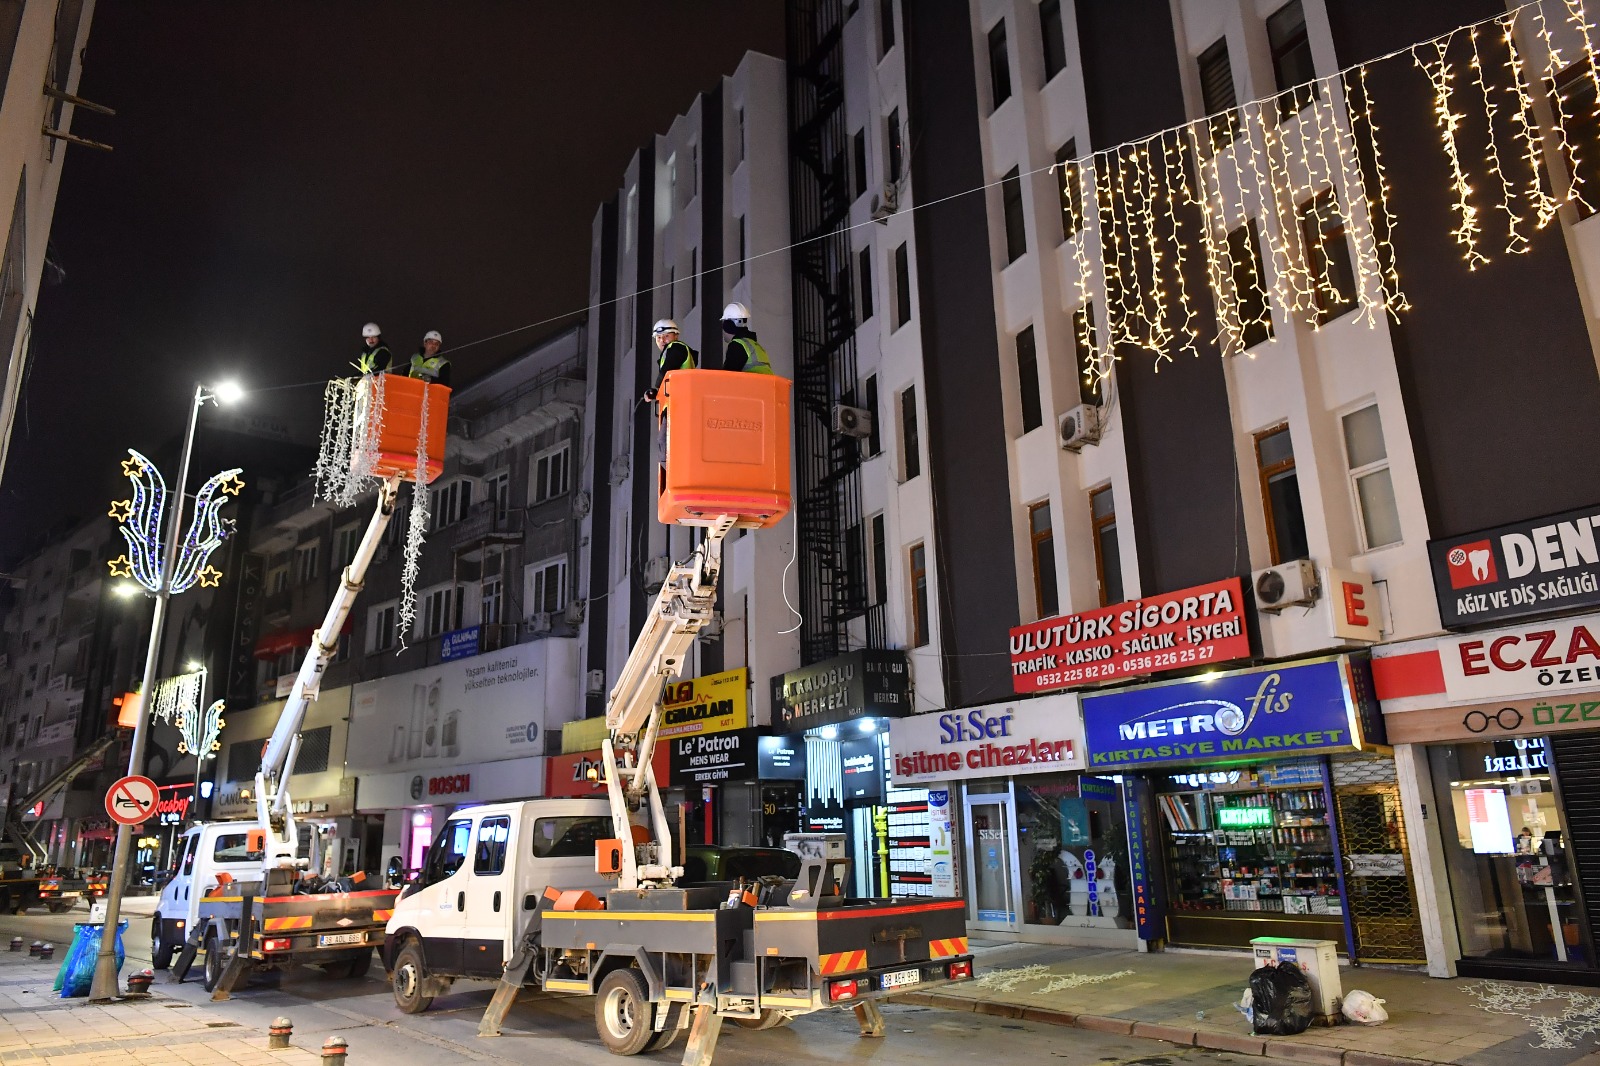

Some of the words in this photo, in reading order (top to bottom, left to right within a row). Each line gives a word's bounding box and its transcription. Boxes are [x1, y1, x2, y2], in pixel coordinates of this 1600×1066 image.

[1342, 581, 1369, 627] E
[1457, 594, 1489, 616] AĞIZ
[1489, 589, 1509, 609] VE
[1513, 583, 1537, 606] DİŞ
[1540, 573, 1598, 601] SAĞLIĞI
[1010, 615, 1114, 656] ULUTÜRK
[1119, 590, 1233, 635] SİGORTA
[1012, 653, 1057, 676] TRAFİK
[1066, 644, 1111, 666] KASKO
[1122, 631, 1175, 656] SAĞLIK
[1187, 616, 1240, 646] İŞYERİ
[466, 665, 486, 678] Yaşam
[487, 656, 518, 673] kalitenizi
[1036, 672, 1061, 686] 0532
[1064, 669, 1083, 682] 225
[1085, 666, 1099, 678] 82
[1101, 663, 1115, 676] 20
[1123, 656, 1152, 672] 0536
[1154, 651, 1177, 668] 226
[1180, 648, 1196, 663] 25
[1199, 646, 1214, 660] 27
[464, 676, 496, 693] yükselten
[497, 668, 539, 684] teknolojiler.
[939, 709, 1012, 745] Si-Ser
[1221, 729, 1344, 752] MARKET
[698, 735, 740, 753] Patron
[894, 750, 963, 777] işitme
[966, 738, 1073, 770] cihazları
[690, 756, 709, 766] MENS
[709, 753, 729, 764] WEAR
[428, 774, 470, 795] BOSCH
[695, 772, 712, 781] ERKEK
[712, 768, 729, 780] GİYİM
[155, 791, 189, 820] ocabey
[764, 803, 776, 815] 50
[930, 794, 946, 802] Si-Ser
[1137, 885, 1146, 926] SARF
